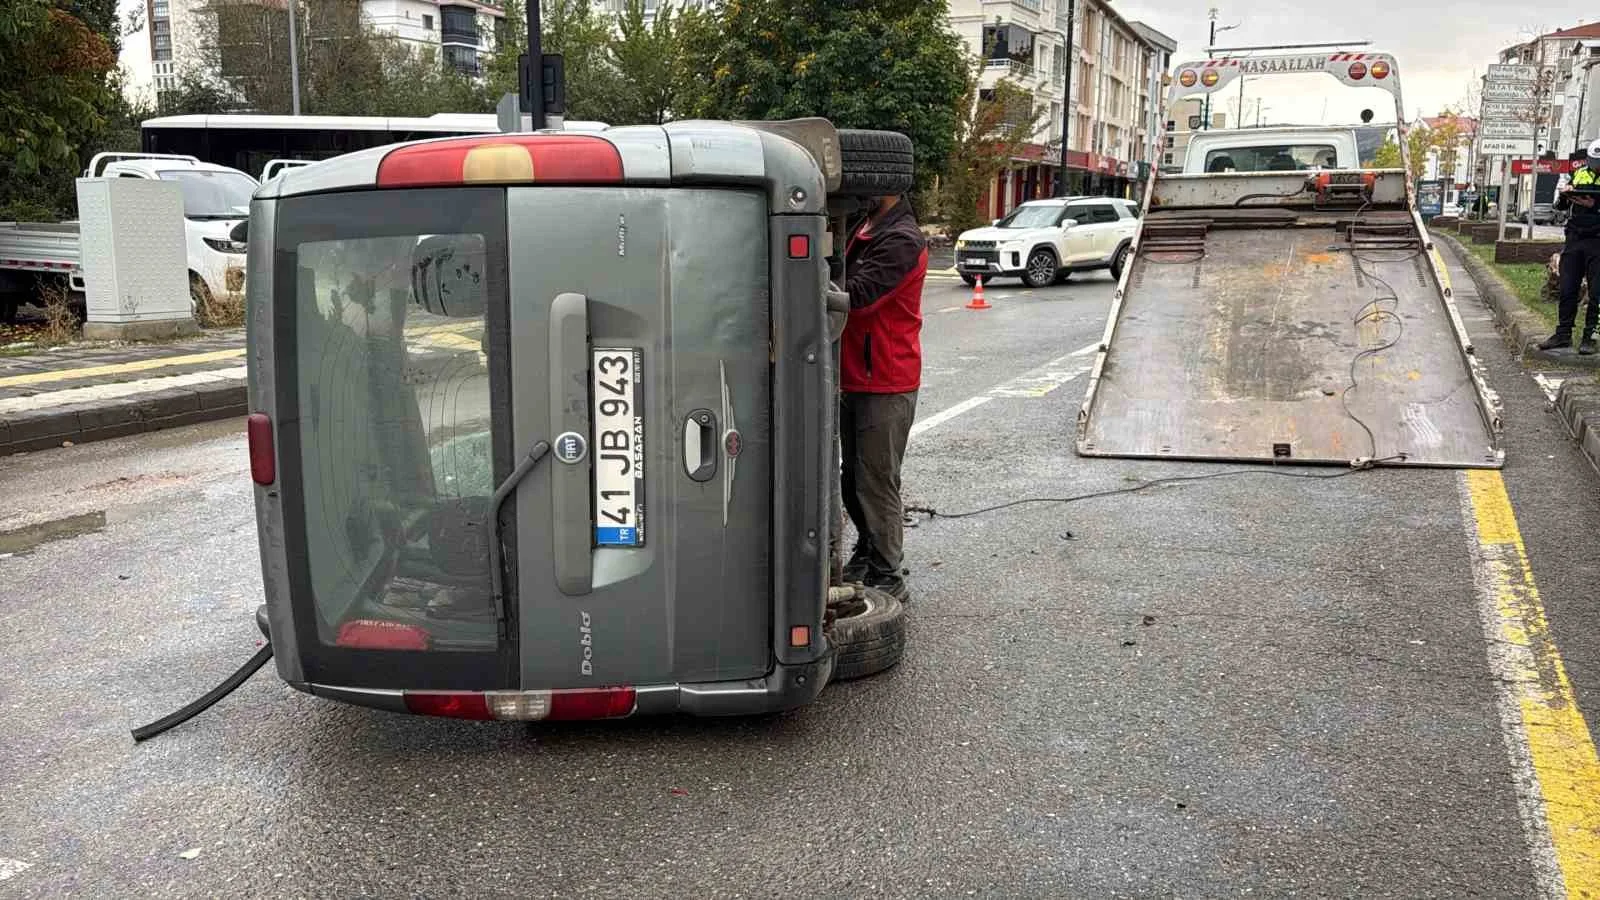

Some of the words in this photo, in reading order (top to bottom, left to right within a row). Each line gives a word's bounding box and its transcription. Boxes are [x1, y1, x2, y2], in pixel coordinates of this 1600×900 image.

[598, 355, 630, 417] 943
[564, 438, 577, 459] FIAT
[600, 430, 631, 476] JB
[600, 490, 631, 525] 41
[619, 528, 629, 541] TR
